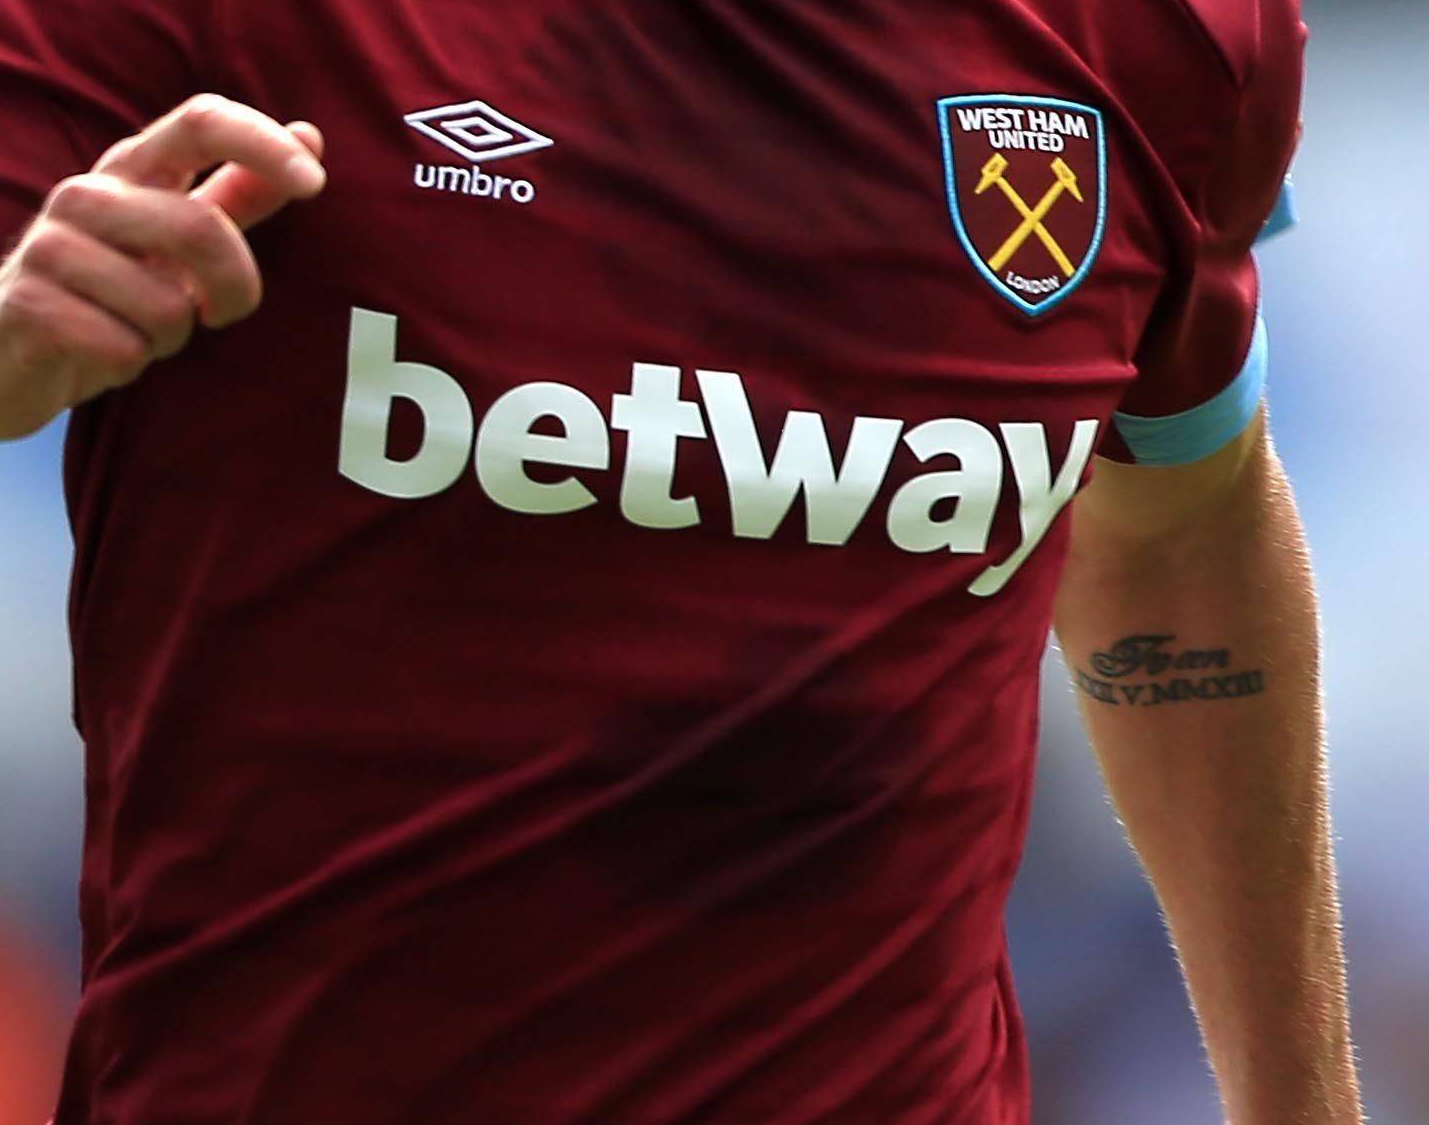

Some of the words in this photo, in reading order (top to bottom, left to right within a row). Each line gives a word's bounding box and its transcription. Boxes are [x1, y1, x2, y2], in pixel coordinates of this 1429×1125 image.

[957, 108, 1024, 131] WEST
[1028, 110, 1090, 139] HAM
[988, 130, 1064, 152] UNITED
[414, 163, 535, 203] umbro
[1006, 271, 1060, 294] LONDON
[338, 306, 1099, 597] betway
